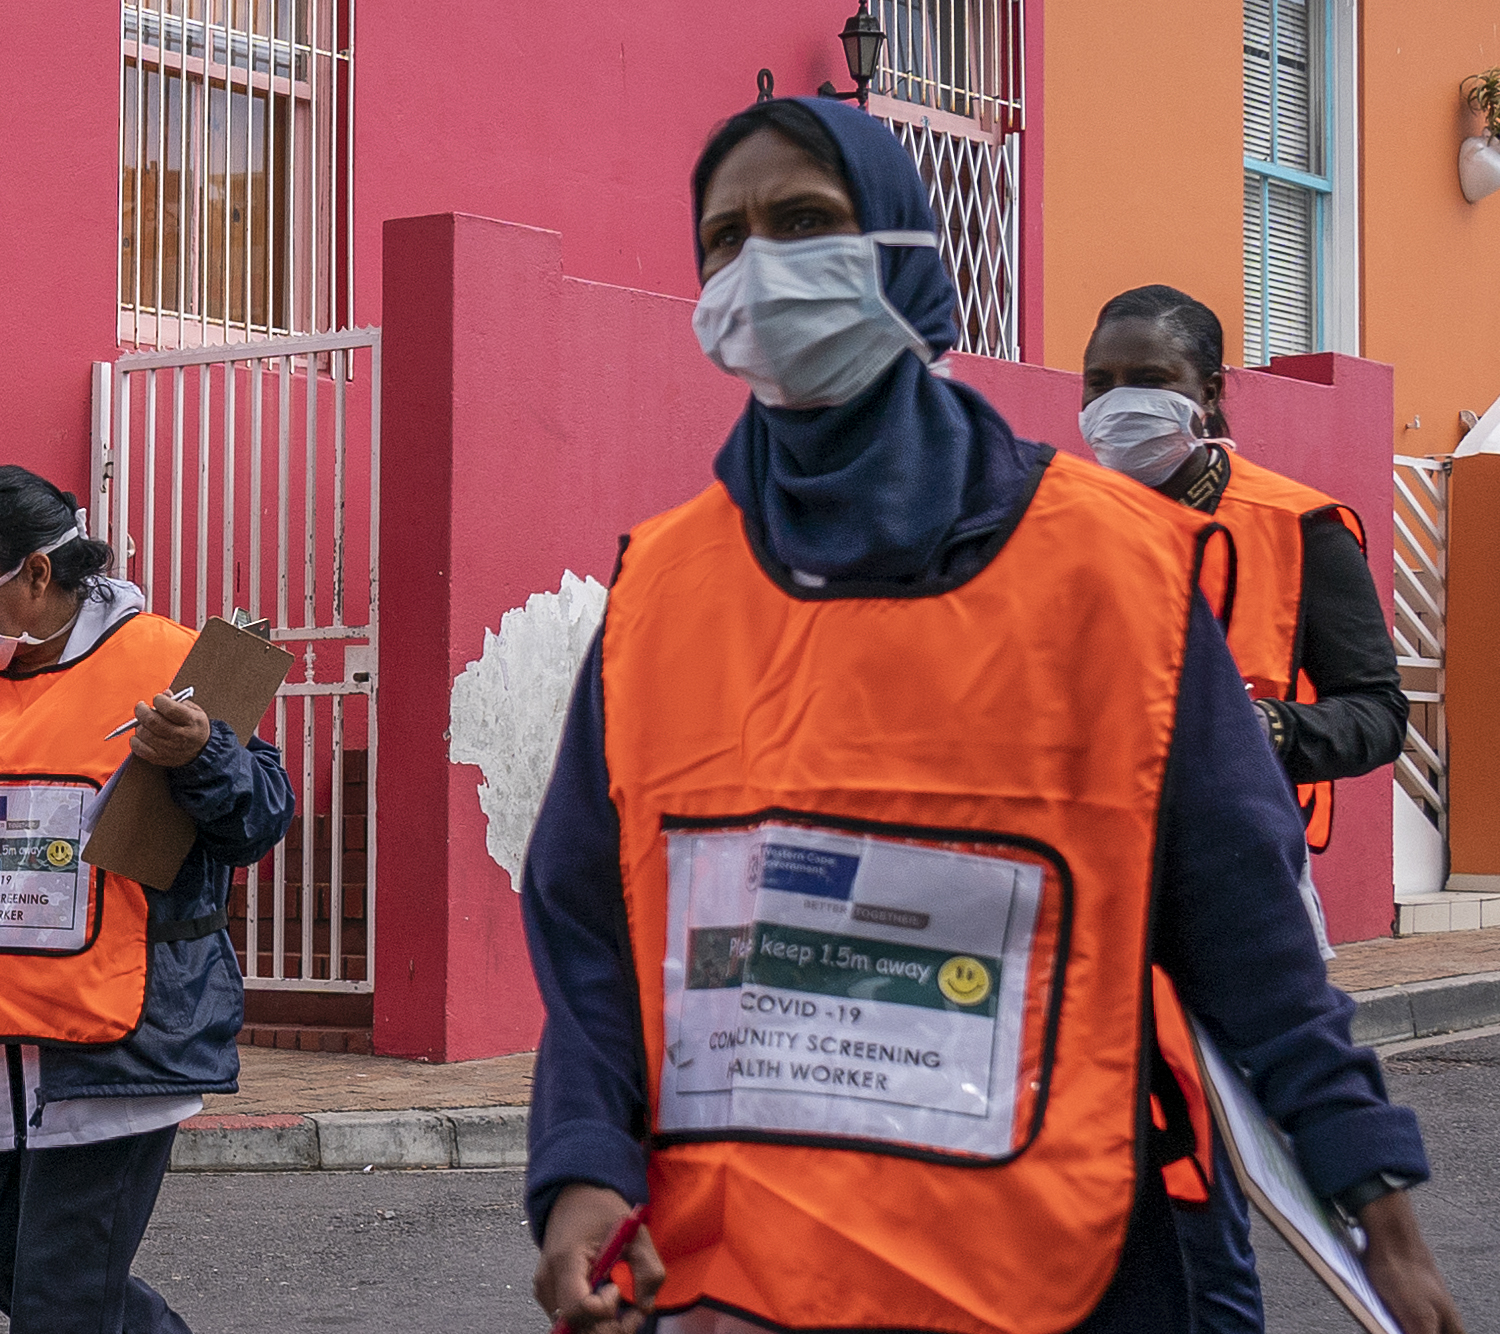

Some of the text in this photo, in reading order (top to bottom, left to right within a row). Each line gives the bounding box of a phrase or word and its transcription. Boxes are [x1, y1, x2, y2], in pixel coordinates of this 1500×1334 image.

[803, 899, 847, 914] BETTER
[759, 933, 814, 966] keep
[819, 943, 869, 970] 1.5m
[875, 957, 931, 985] away
[740, 992, 862, 1023] COVID -19
[805, 1034, 941, 1069] SCREENING
[789, 1061, 889, 1091] WORKER
